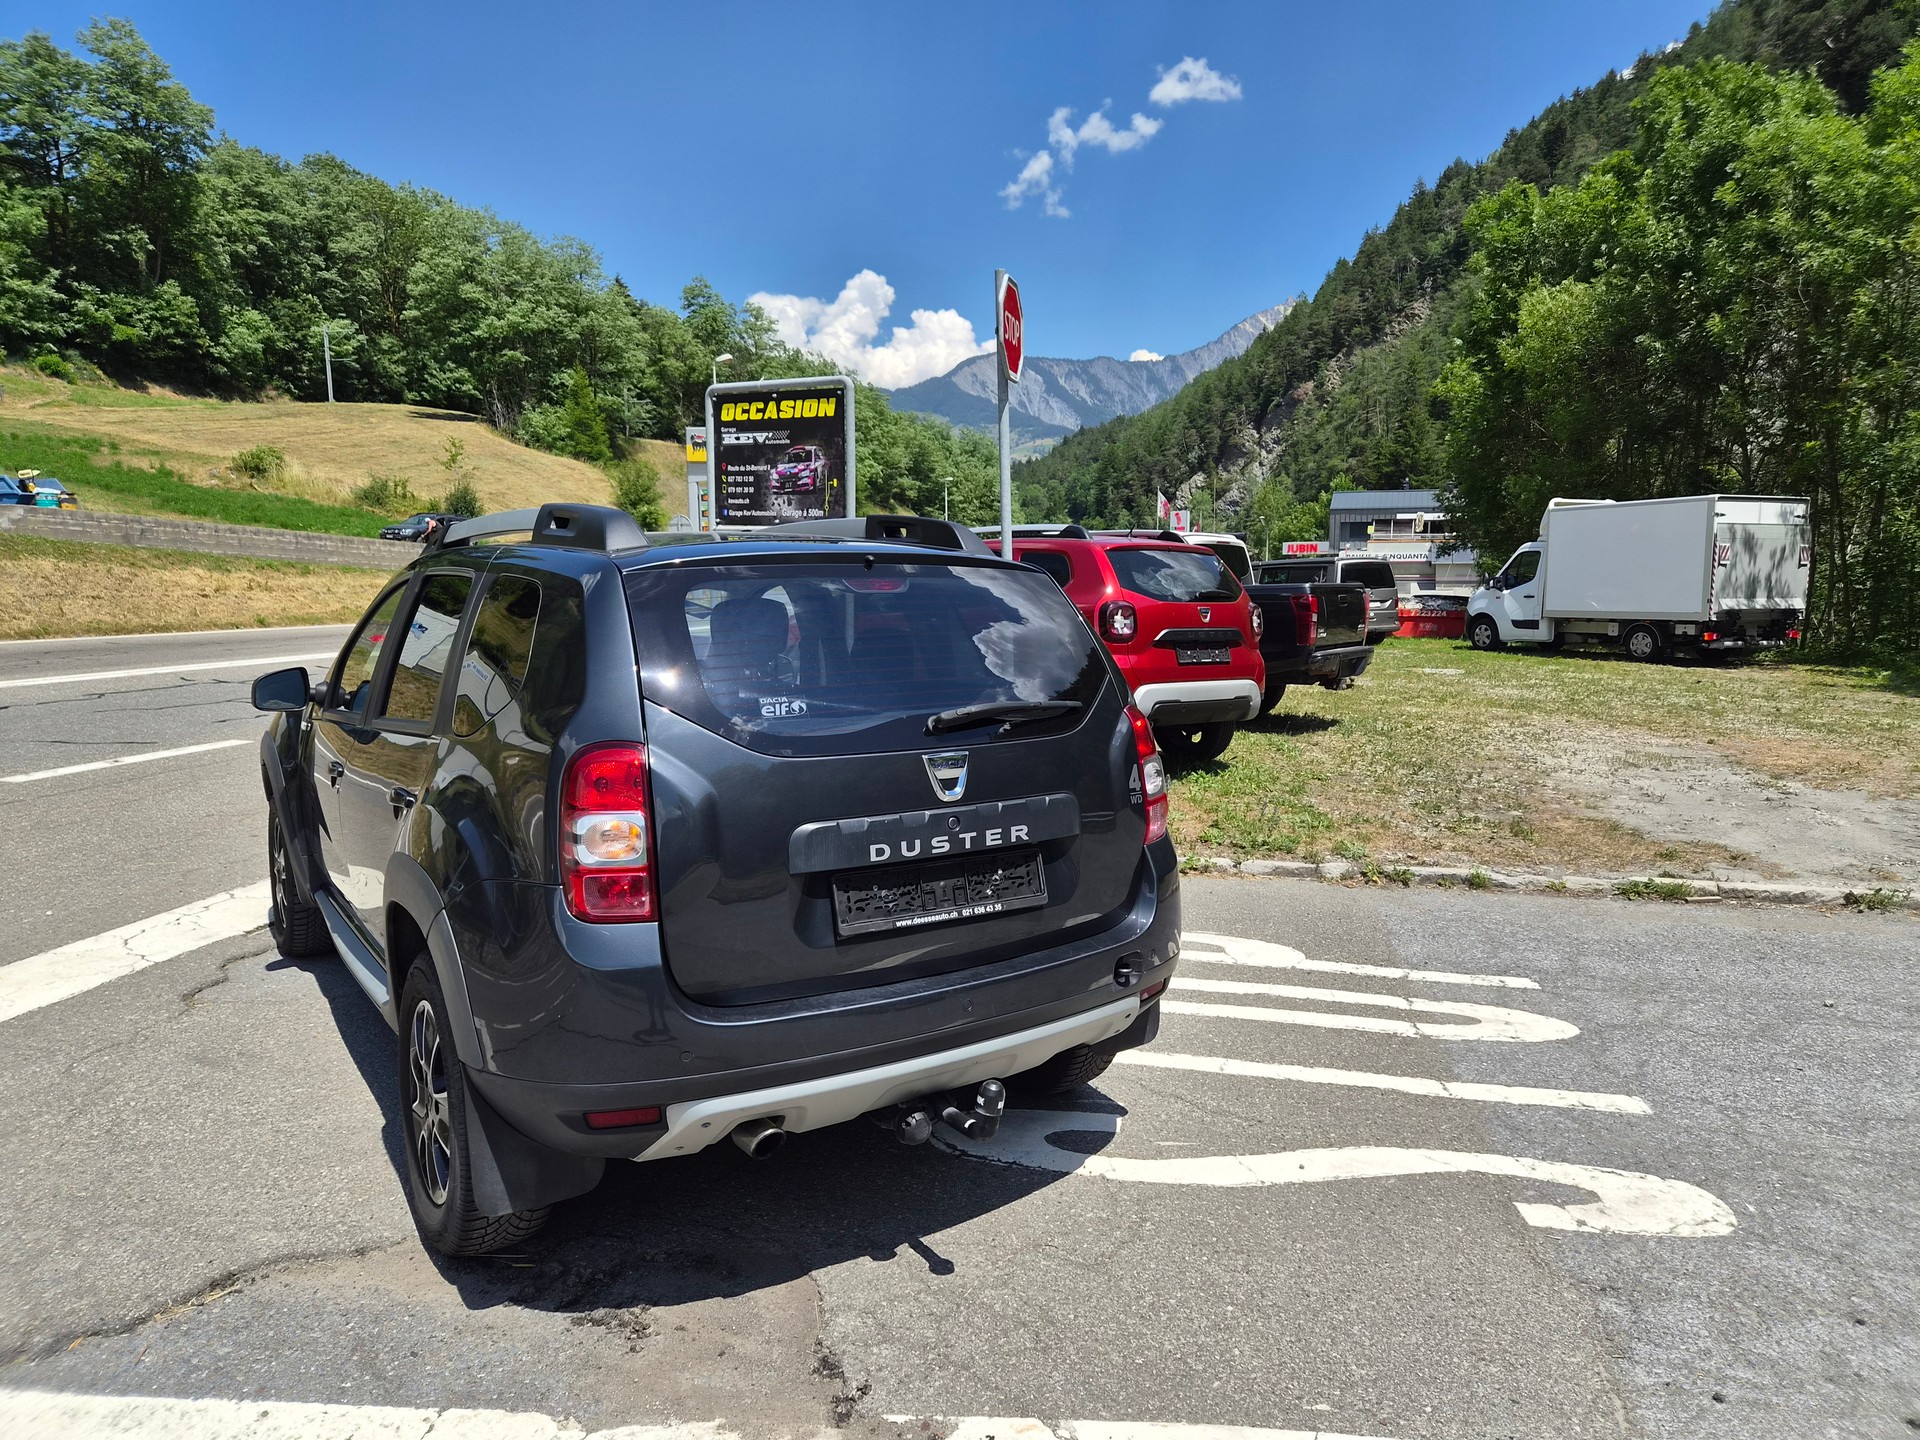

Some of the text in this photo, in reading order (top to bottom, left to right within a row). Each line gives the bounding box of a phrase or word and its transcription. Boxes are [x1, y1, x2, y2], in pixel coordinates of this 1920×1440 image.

[1005, 310, 1020, 347] STOP
[721, 398, 836, 421] OCCASION
[728, 509, 743, 517] Garage
[781, 508, 802, 518] Garage
[808, 508, 824, 517] 500m
[1287, 543, 1318, 554] JUBIN
[761, 703, 789, 716] elf
[1129, 763, 1141, 791] 4
[1130, 795, 1143, 804] WD
[869, 824, 1030, 862] DUSTER
[895, 910, 958, 927] www.deesseauto.ch
[962, 908, 973, 917] 021
[994, 903, 1002, 911] 35
